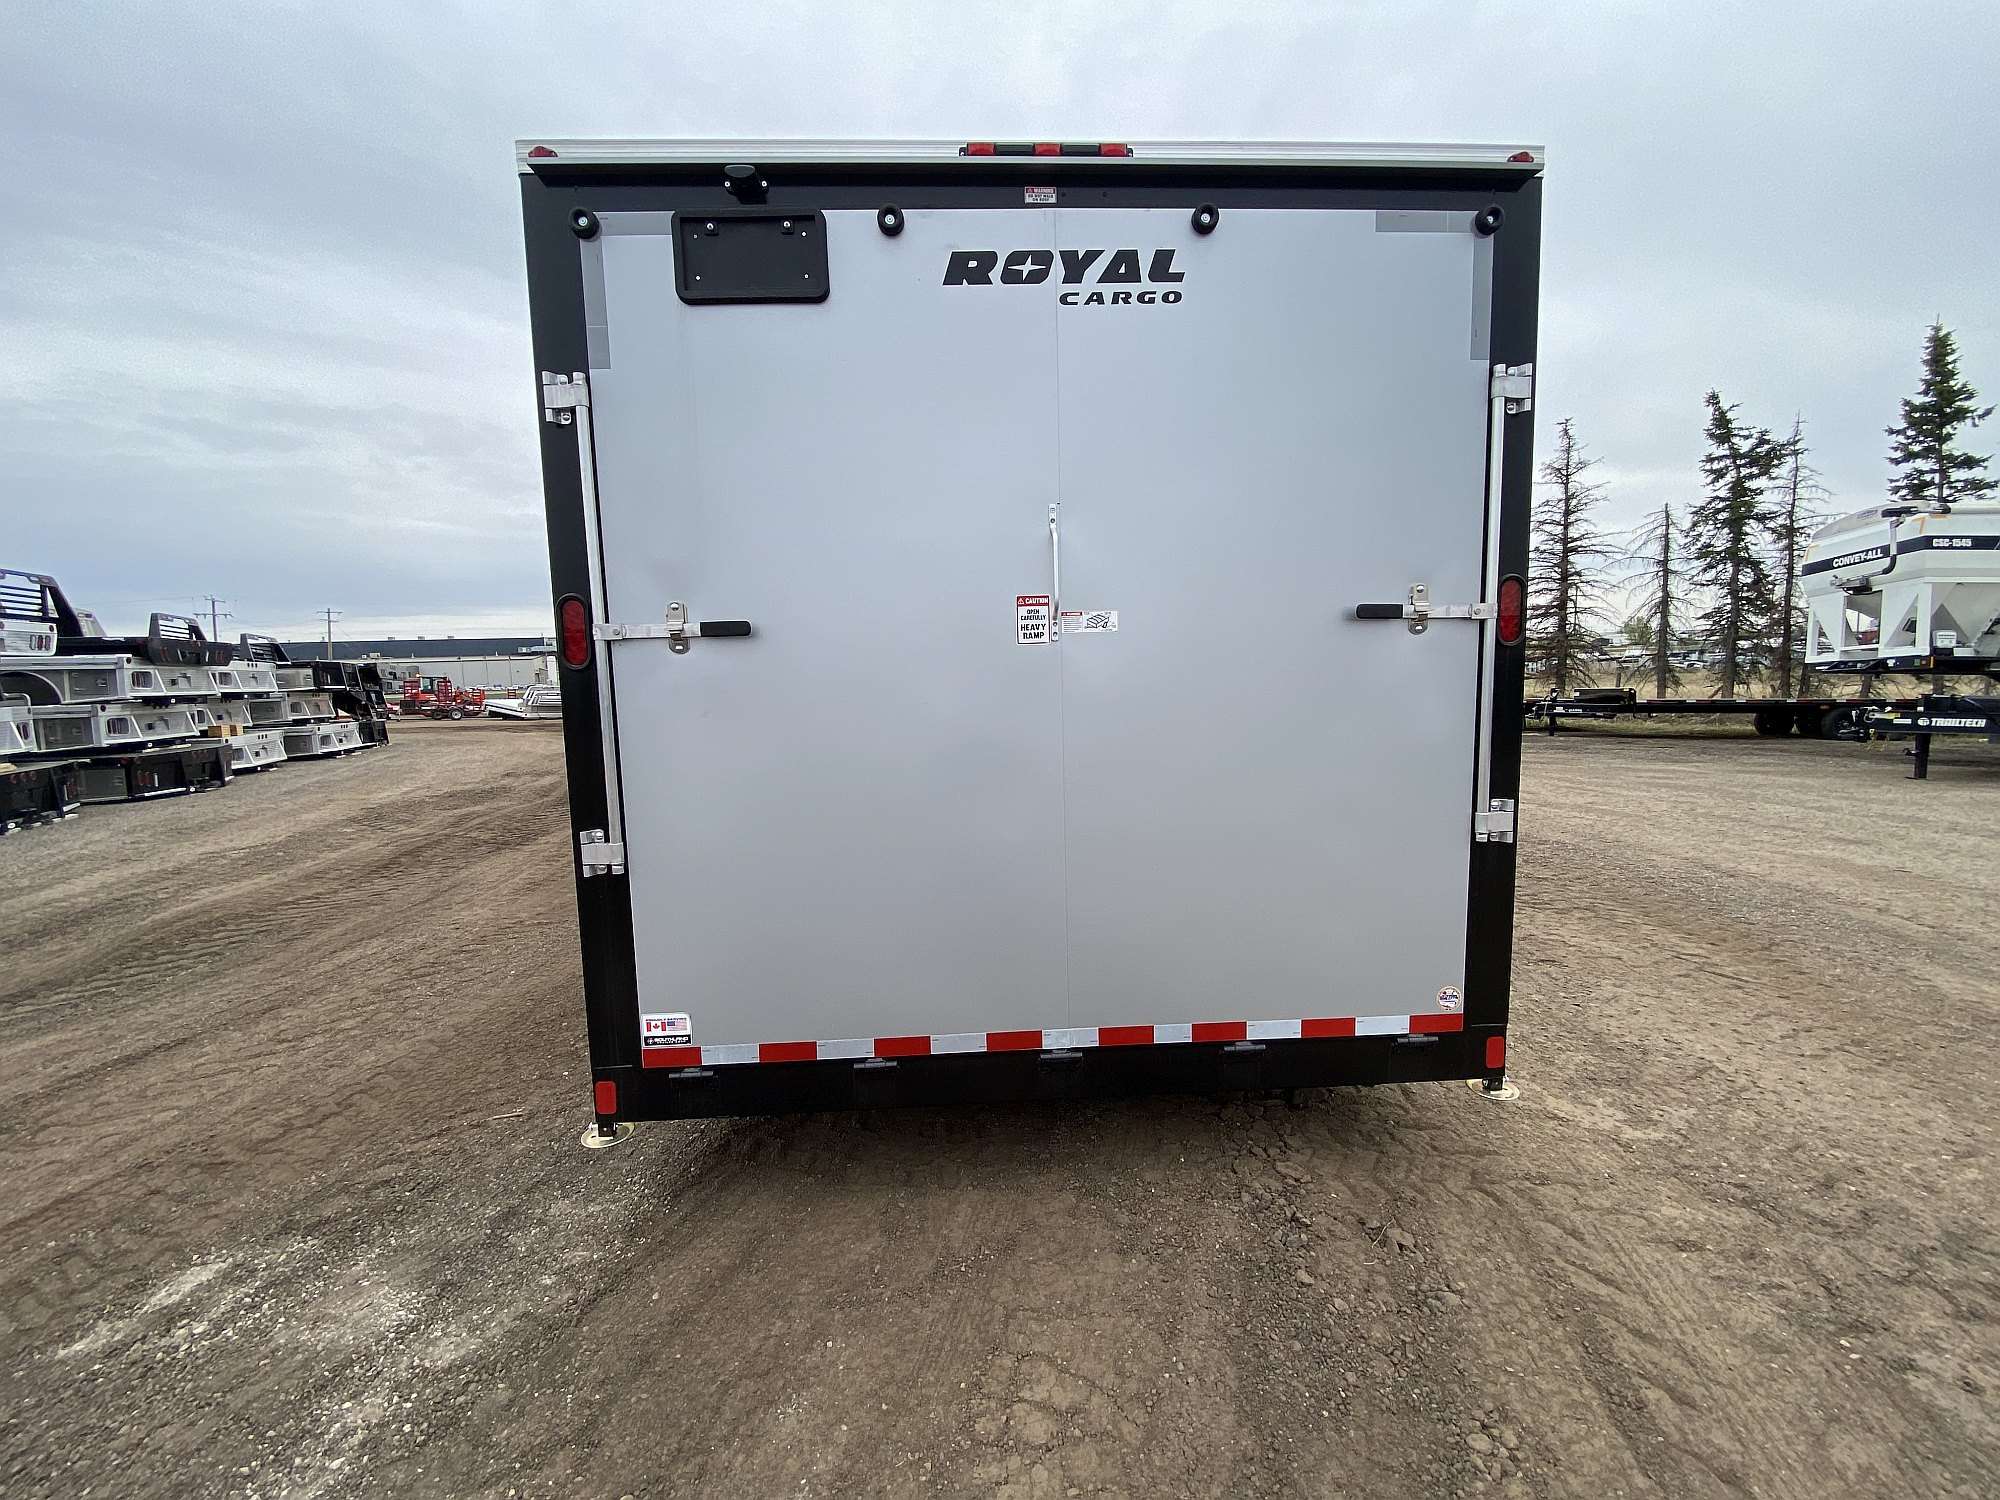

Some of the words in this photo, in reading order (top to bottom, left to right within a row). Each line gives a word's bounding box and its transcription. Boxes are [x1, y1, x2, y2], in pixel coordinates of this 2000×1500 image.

[942, 248, 1186, 286] ROYAL
[1059, 290, 1183, 306] CARGO
[1832, 549, 1883, 568] CONVEY-ALL
[1020, 623, 1047, 632] HEAVY
[1023, 631, 1045, 640] RAMP
[1930, 718, 1986, 727] TRAILTECH
